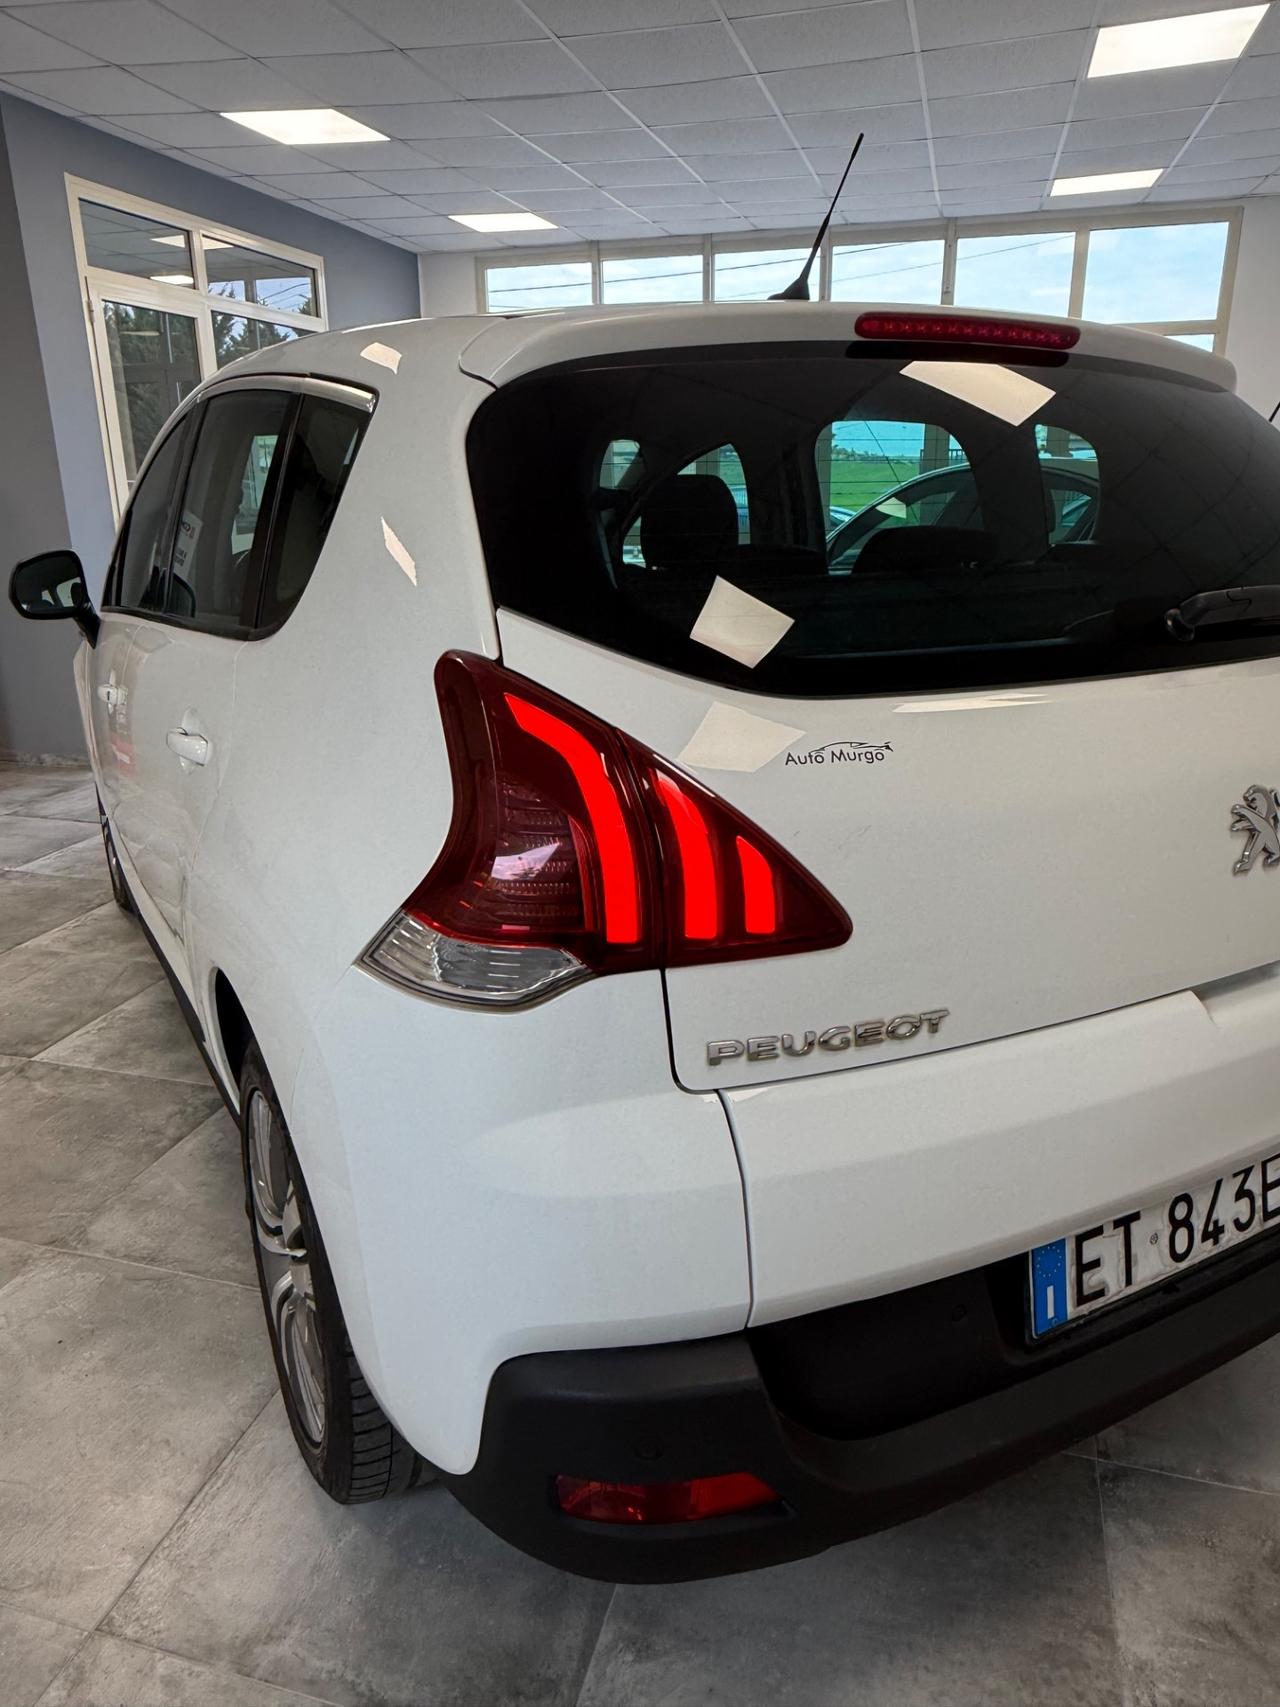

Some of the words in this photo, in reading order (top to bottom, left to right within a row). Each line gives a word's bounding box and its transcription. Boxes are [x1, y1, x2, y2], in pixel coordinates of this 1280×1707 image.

[785, 752, 825, 766] Auto
[831, 748, 885, 764] Murgo
[706, 1008, 950, 1066] PEUGEOT
[1075, 1211, 1141, 1307] ET
